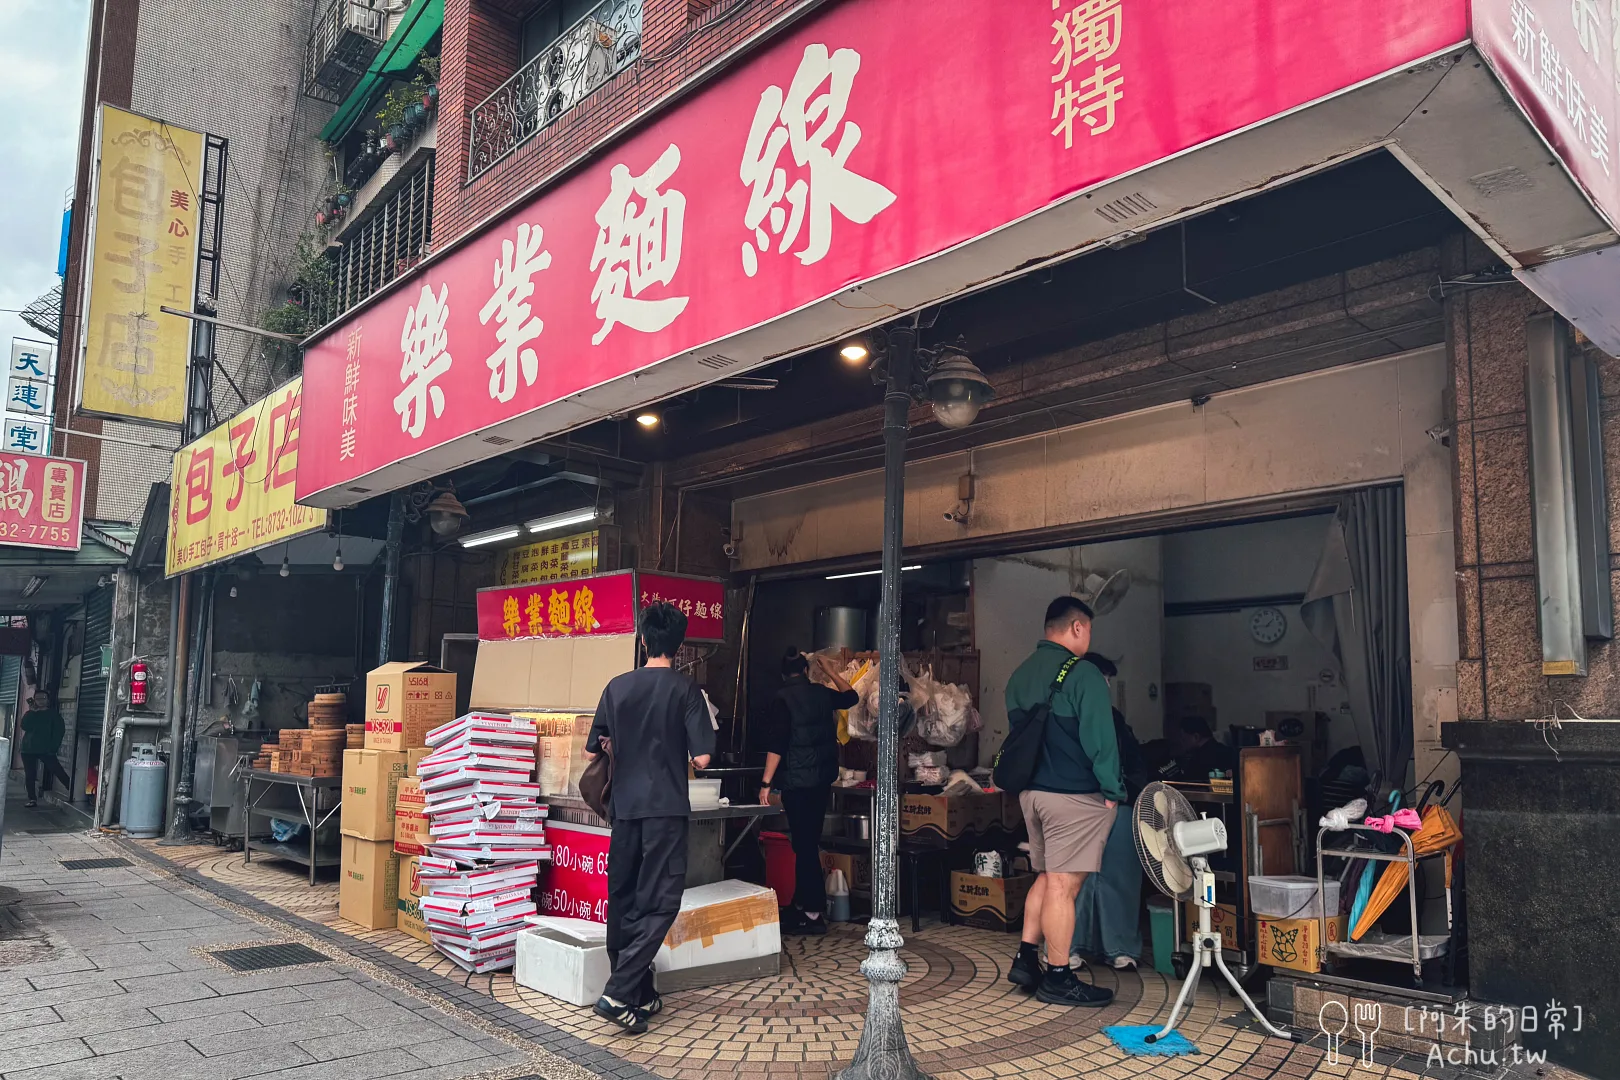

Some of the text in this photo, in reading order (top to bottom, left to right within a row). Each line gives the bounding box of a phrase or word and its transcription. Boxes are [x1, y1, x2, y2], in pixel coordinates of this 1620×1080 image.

[1050, 0, 1124, 150] 獨特
[1510, 0, 1610, 177] 新鮮味美
[165, 189, 190, 304] 美心手工
[393, 42, 898, 438] 樂業麵線
[10, 352, 46, 450] 天連堂
[339, 325, 363, 462] 新鮮味美
[47, 466, 68, 519] 專賣店
[185, 389, 302, 526] 包子店
[502, 584, 598, 638] 樂業麵線
[551, 844, 594, 875] 80小碗
